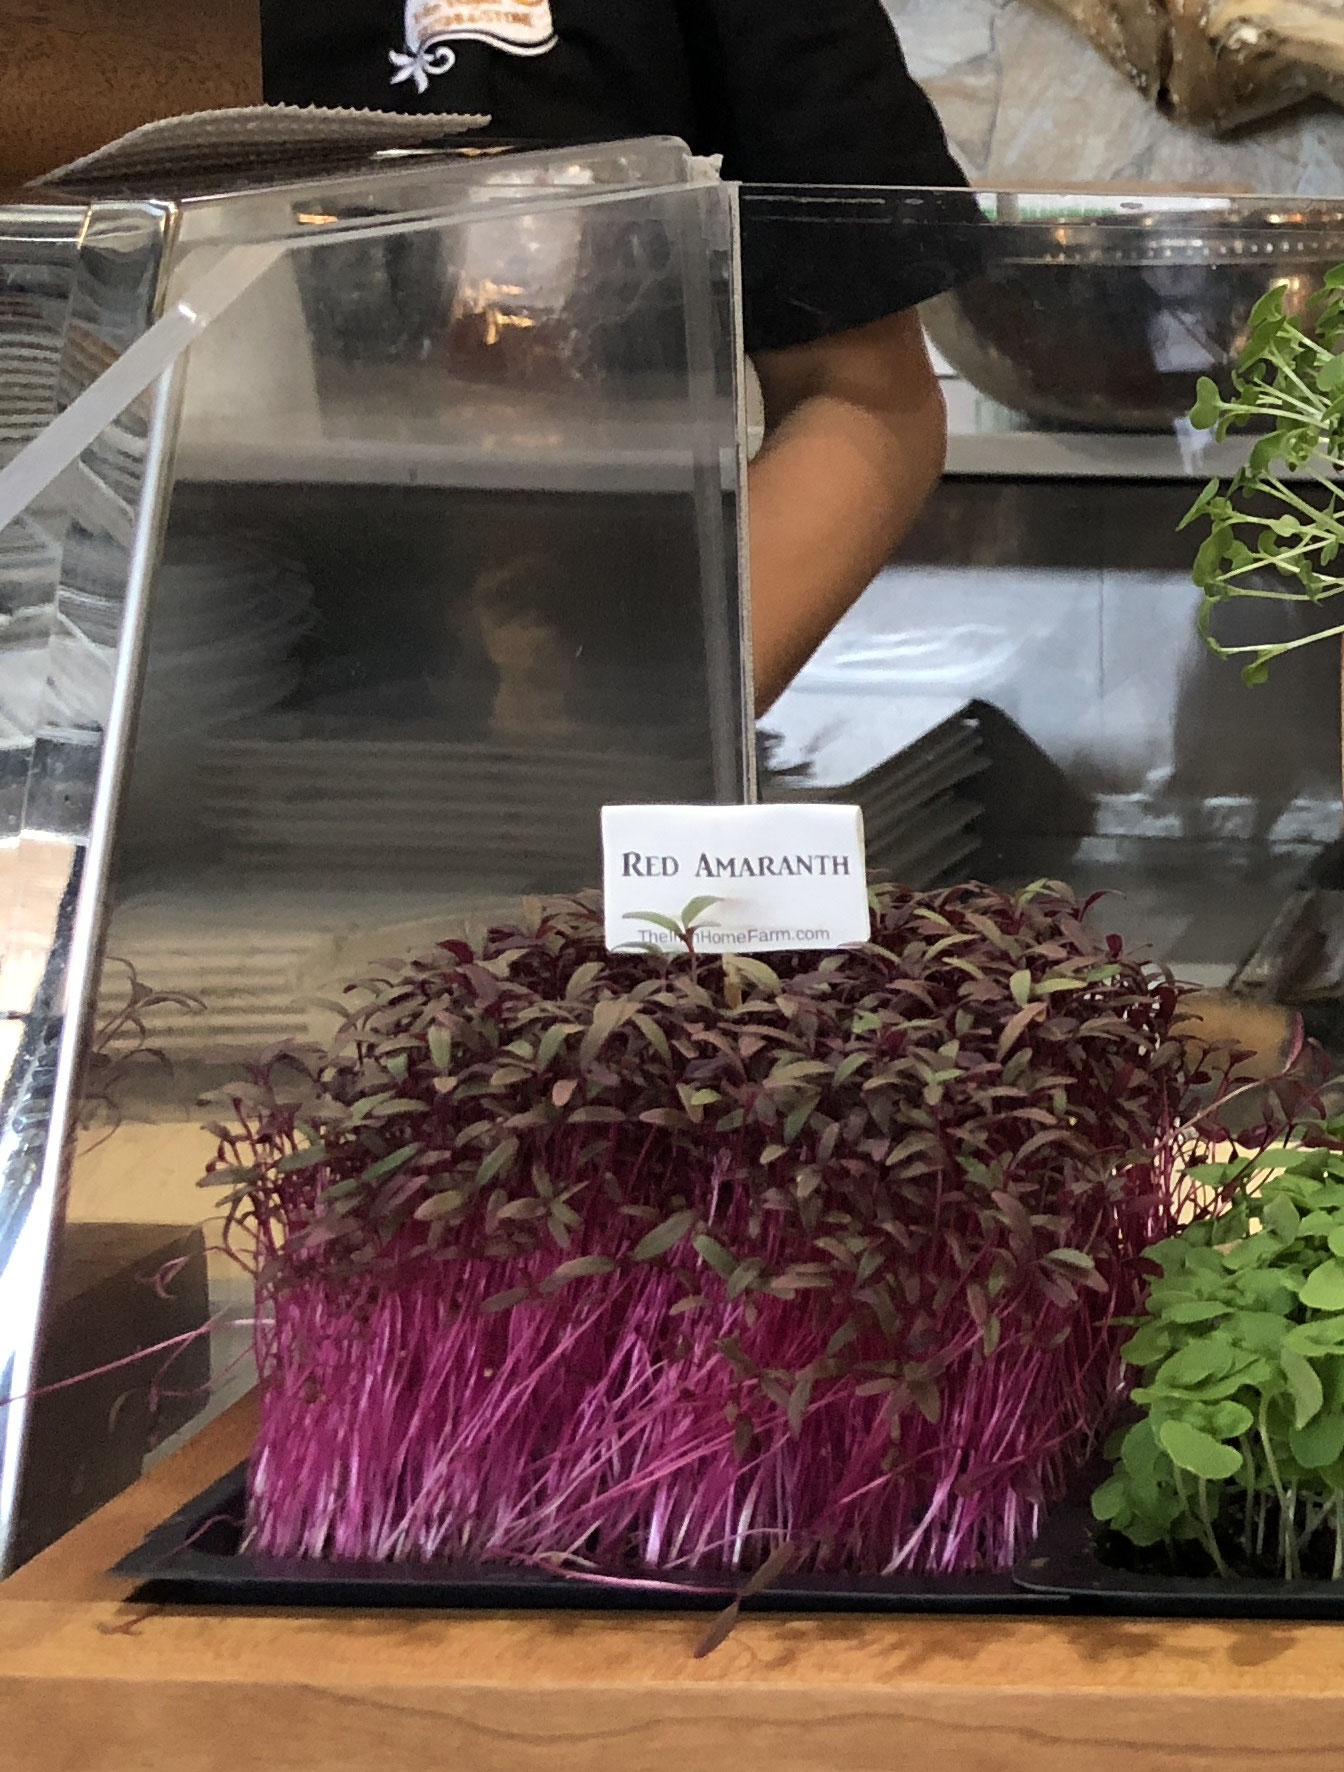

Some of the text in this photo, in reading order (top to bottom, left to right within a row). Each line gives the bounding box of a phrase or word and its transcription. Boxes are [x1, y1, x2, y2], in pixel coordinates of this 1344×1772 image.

[621, 850, 851, 879] RED AMARANTH
[637, 928, 830, 945] TheIHomeFarm.com
